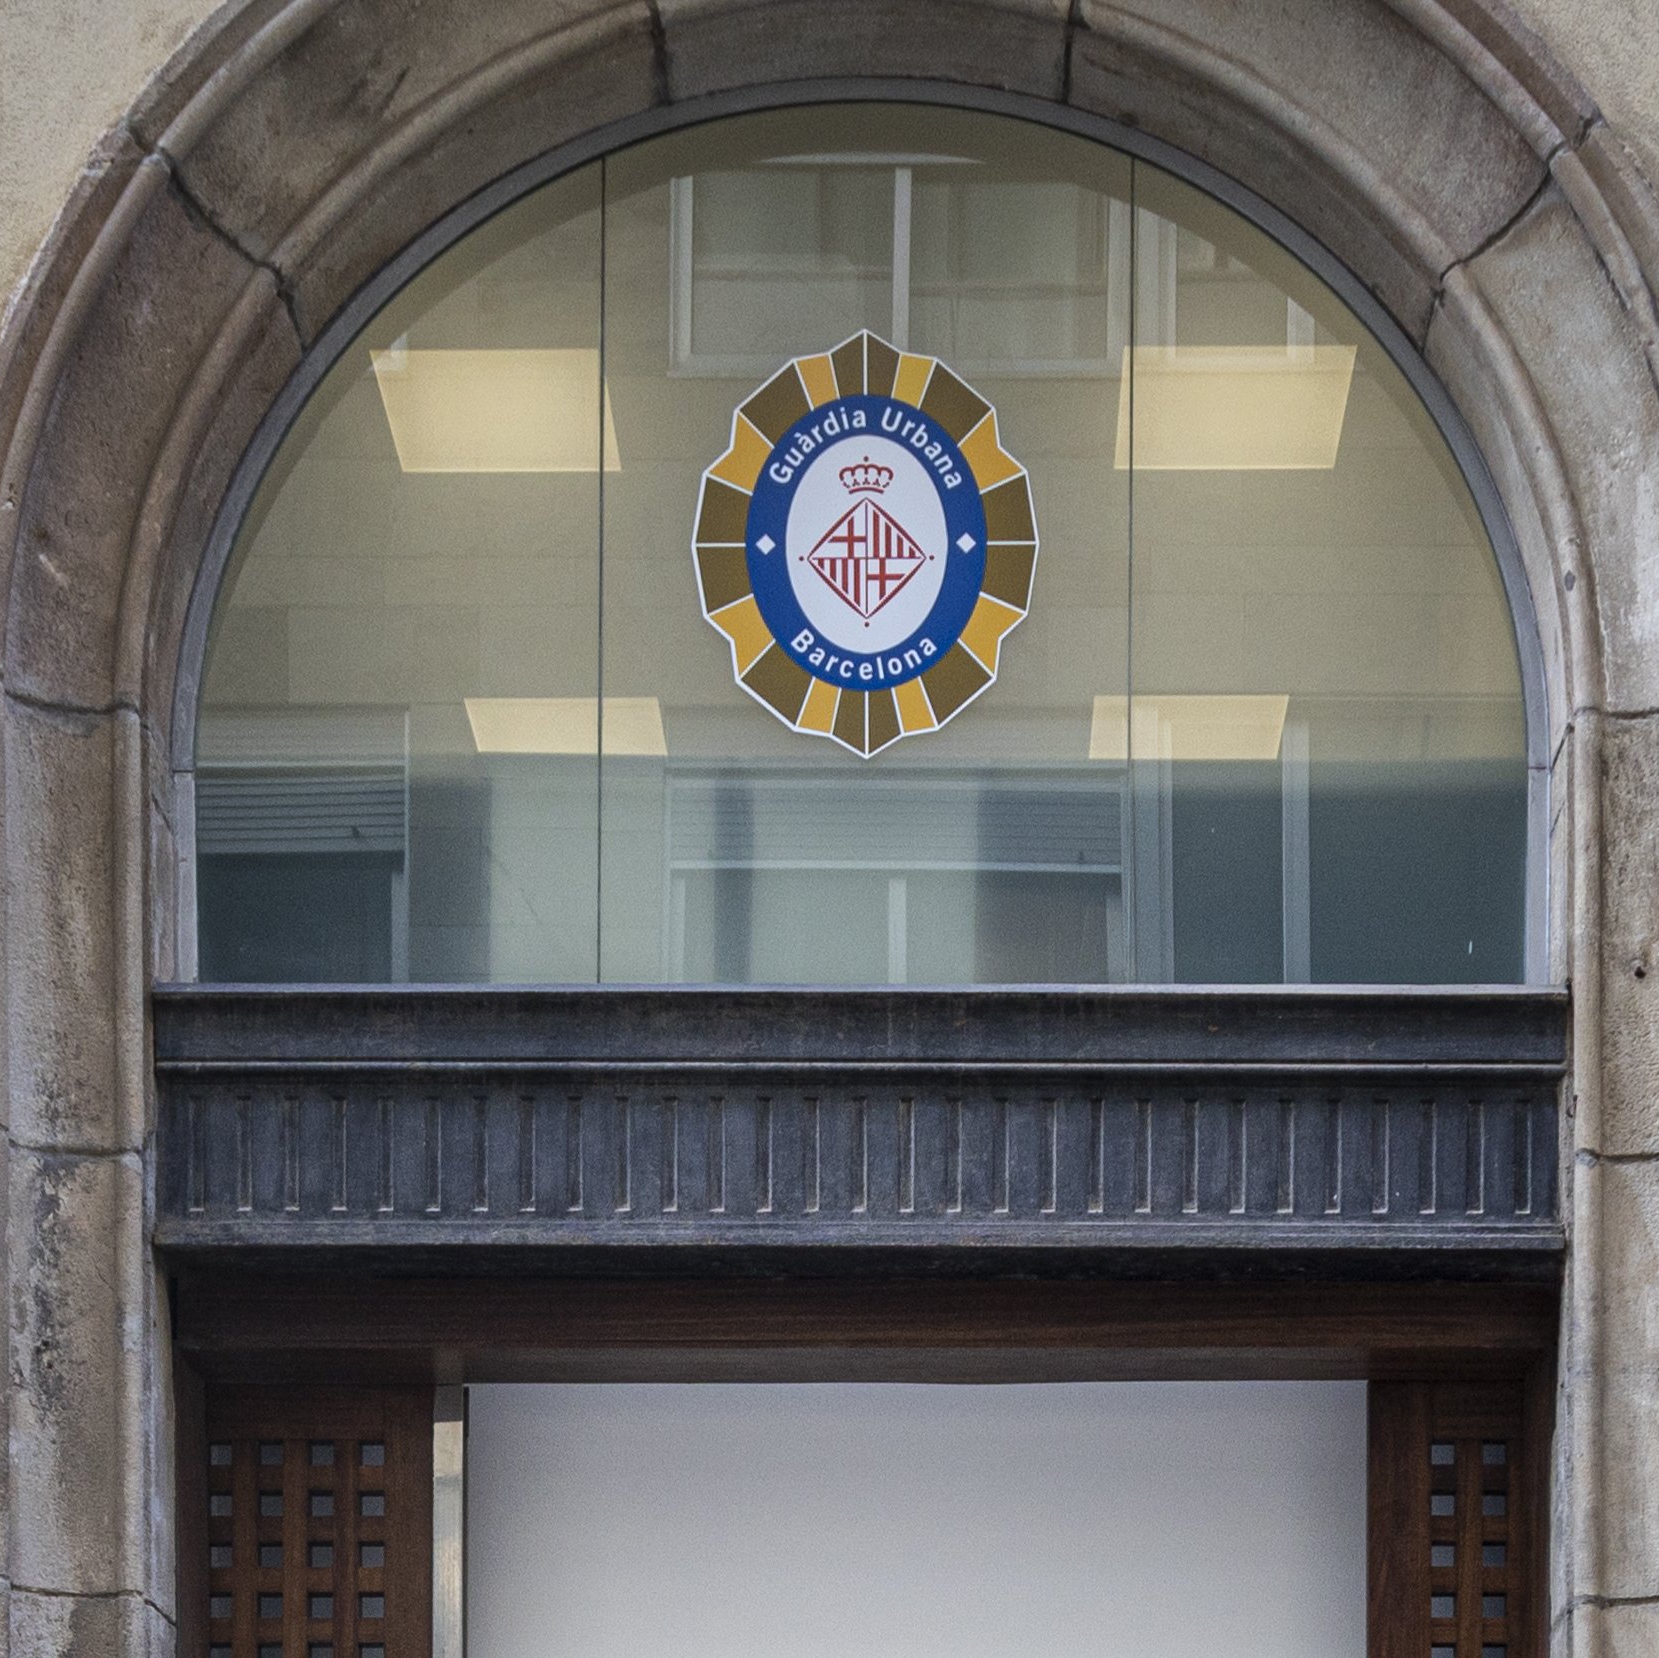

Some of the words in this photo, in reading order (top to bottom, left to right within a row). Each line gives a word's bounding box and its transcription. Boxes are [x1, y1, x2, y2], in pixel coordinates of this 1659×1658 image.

[769, 407, 867, 485] Guàrdia
[881, 407, 961, 490] Urbana
[790, 628, 937, 680] Barcelona
